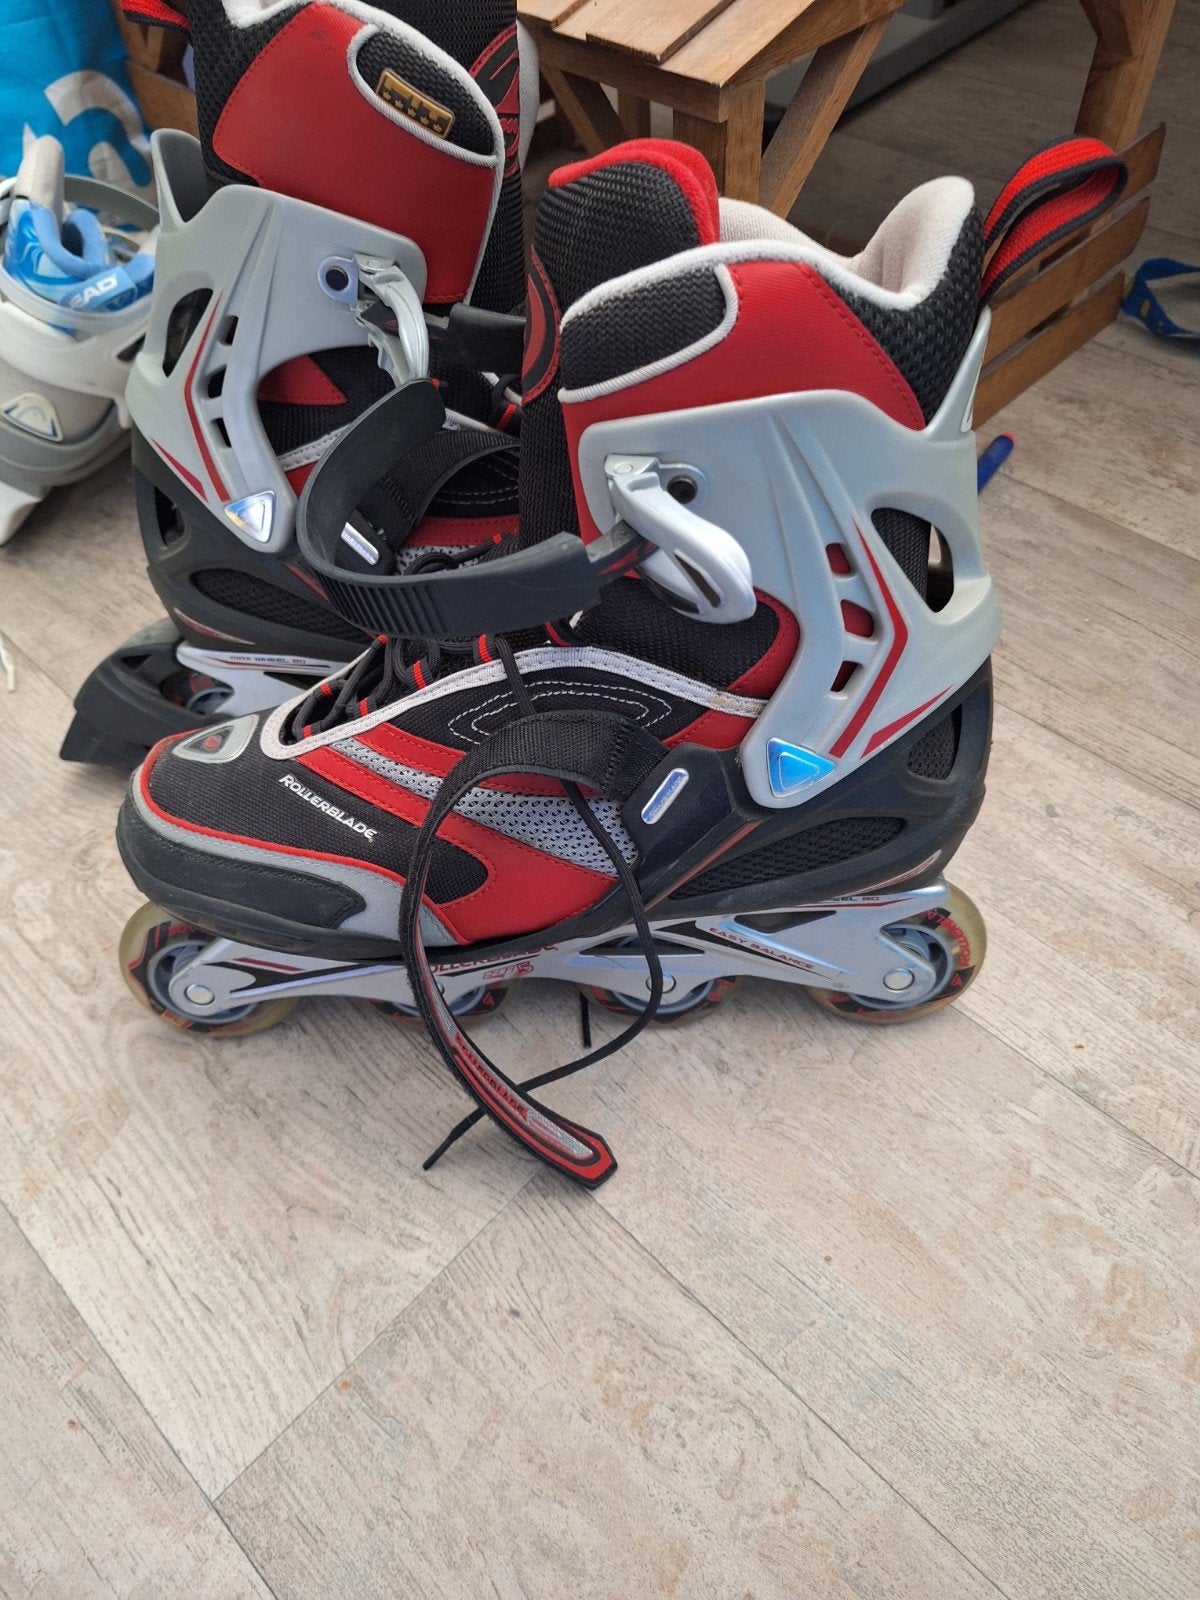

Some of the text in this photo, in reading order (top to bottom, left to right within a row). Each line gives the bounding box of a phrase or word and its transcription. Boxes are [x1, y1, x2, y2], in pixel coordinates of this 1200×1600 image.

[69, 274, 119, 309] EAD
[279, 774, 378, 840] ROLLERBLADE
[709, 926, 815, 970] EASY BALANCE
